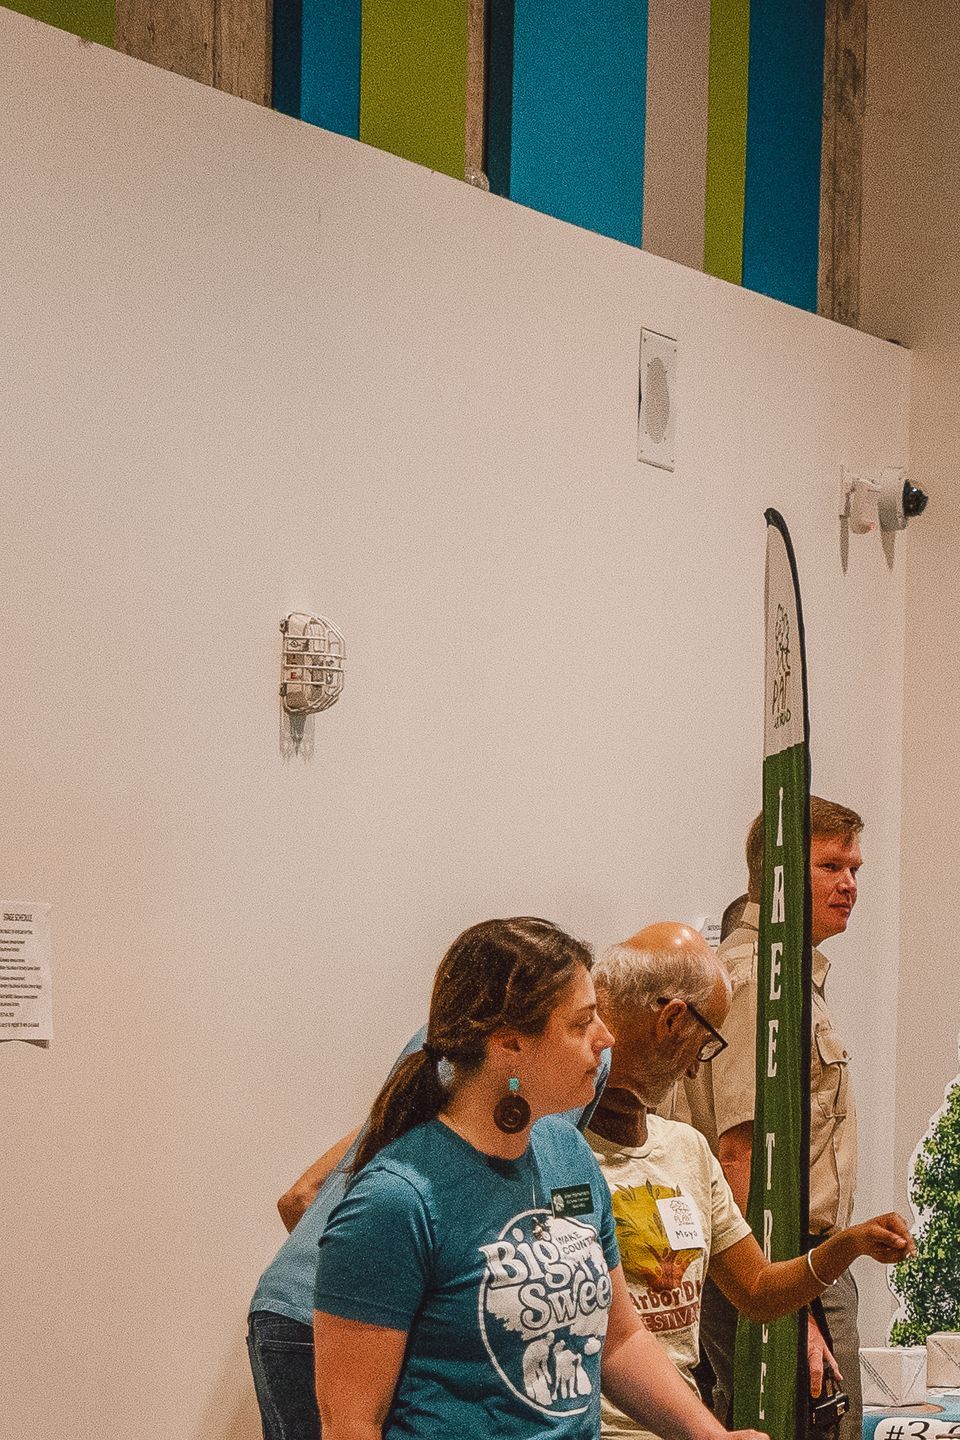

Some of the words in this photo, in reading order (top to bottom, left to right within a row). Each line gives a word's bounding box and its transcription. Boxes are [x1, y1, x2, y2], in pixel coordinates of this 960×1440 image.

[556, 1231, 583, 1245] WAKE
[562, 1237, 592, 1255] COUNT
[479, 1228, 573, 1290] Big
[520, 1270, 613, 1331] Swee
